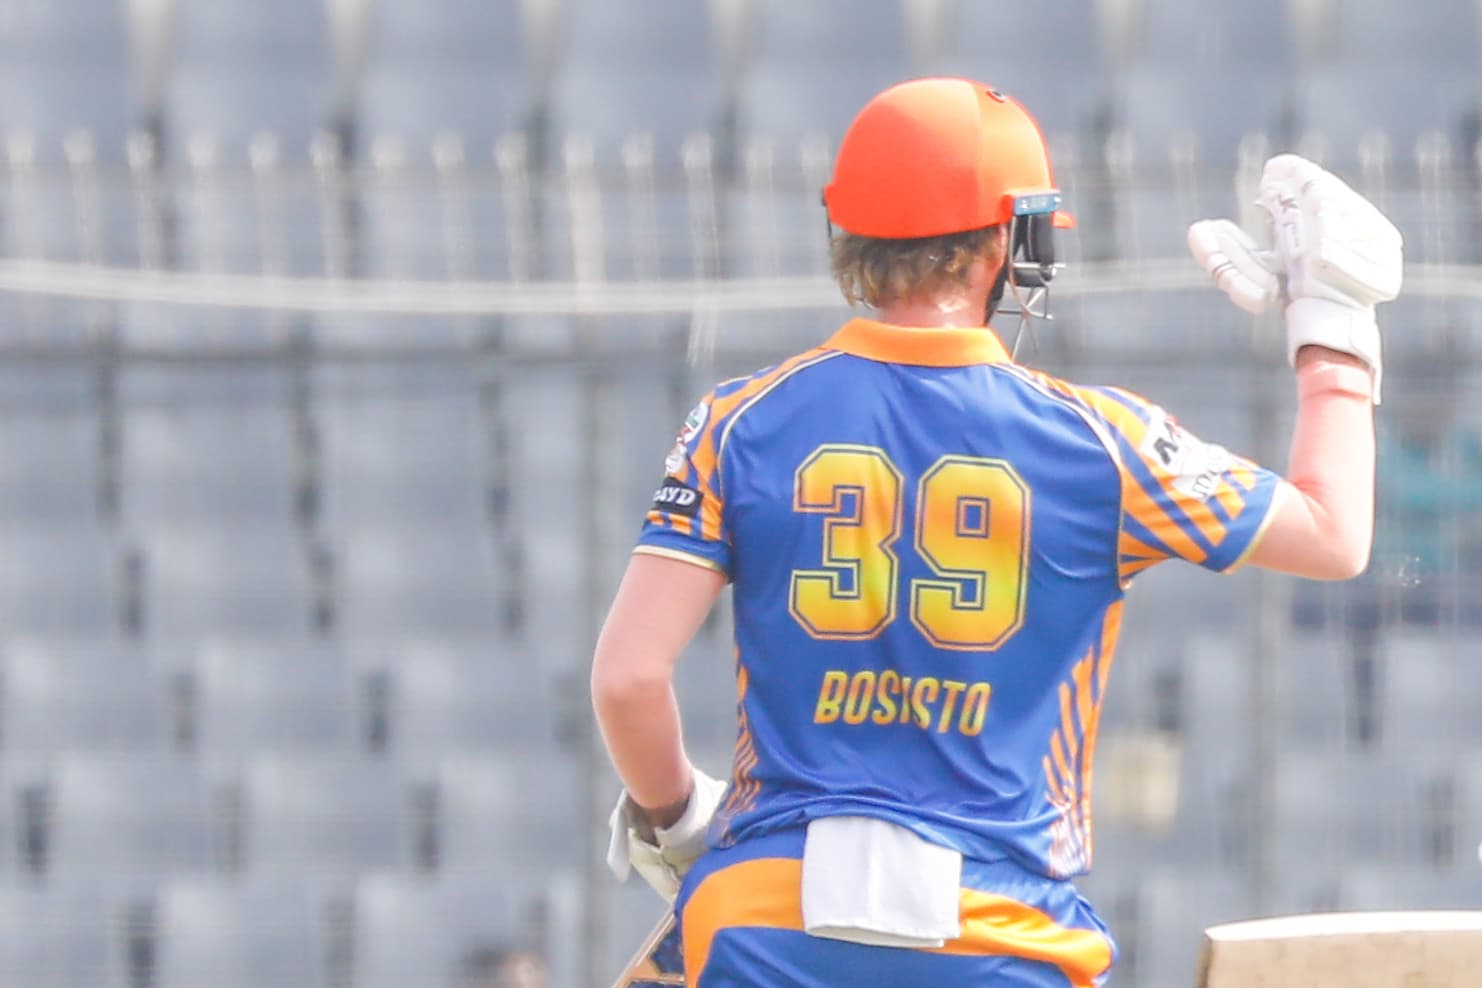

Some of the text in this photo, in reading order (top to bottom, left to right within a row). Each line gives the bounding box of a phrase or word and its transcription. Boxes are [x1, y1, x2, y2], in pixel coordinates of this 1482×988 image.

[653, 486, 697, 506] AYD
[788, 443, 1031, 652] 39
[814, 669, 992, 737] BOSISTO
